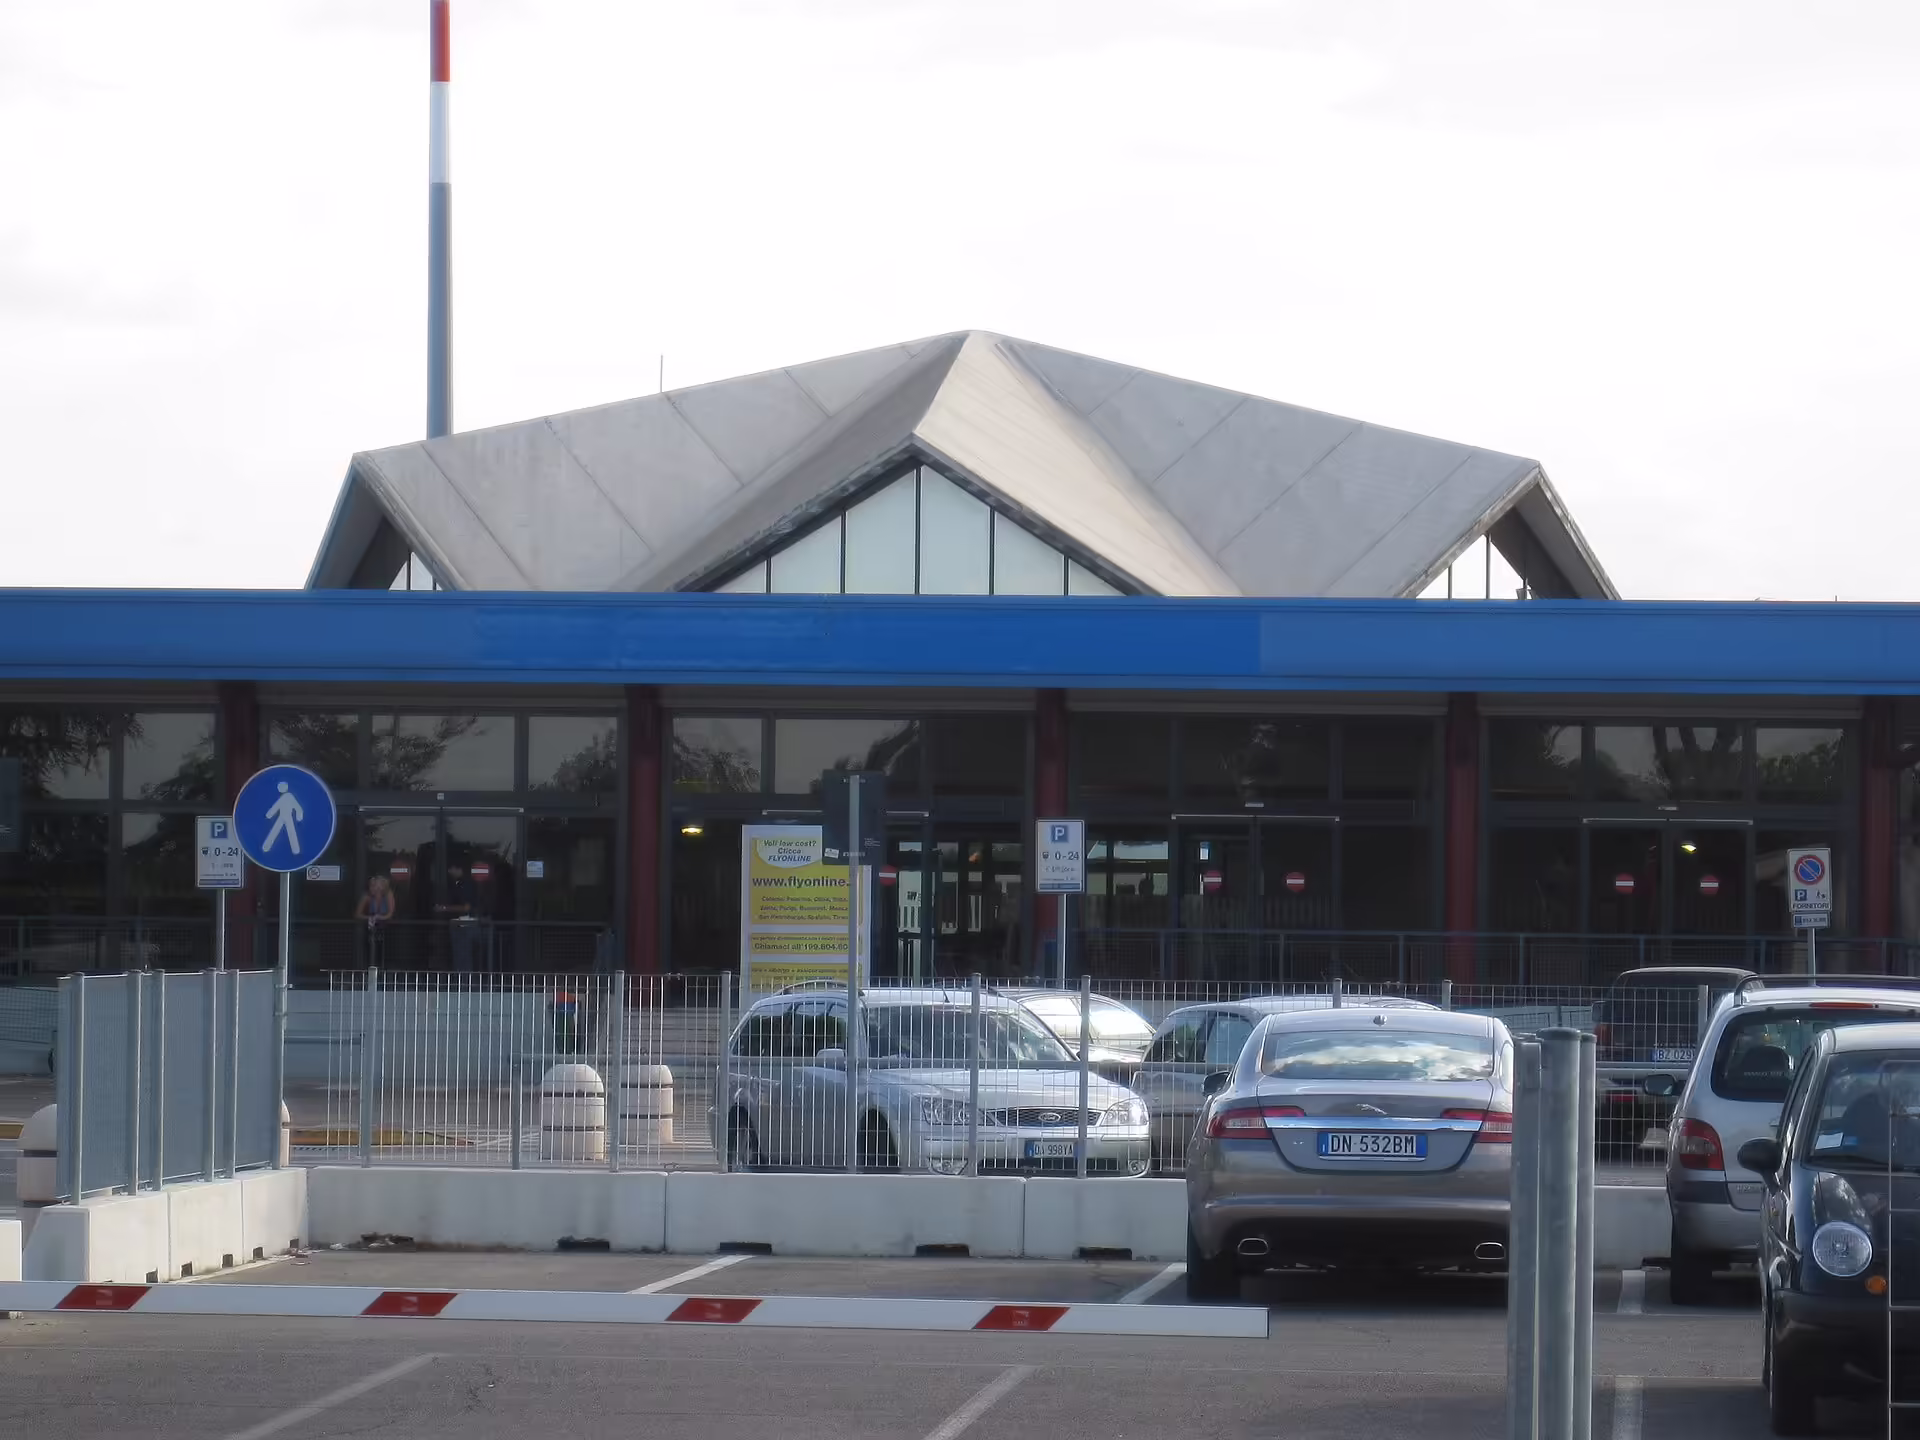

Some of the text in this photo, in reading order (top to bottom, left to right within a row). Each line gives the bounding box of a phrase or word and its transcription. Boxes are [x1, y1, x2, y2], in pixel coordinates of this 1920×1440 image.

[213, 822, 225, 837] P
[1054, 826, 1065, 841] P
[779, 839, 794, 847] low
[795, 839, 817, 847] cost?
[1792, 902, 1830, 910] FORNITORI
[1047, 1143, 1073, 1156] 998YA
[1330, 1134, 1353, 1154] DN
[1359, 1134, 1416, 1155] 532BM
